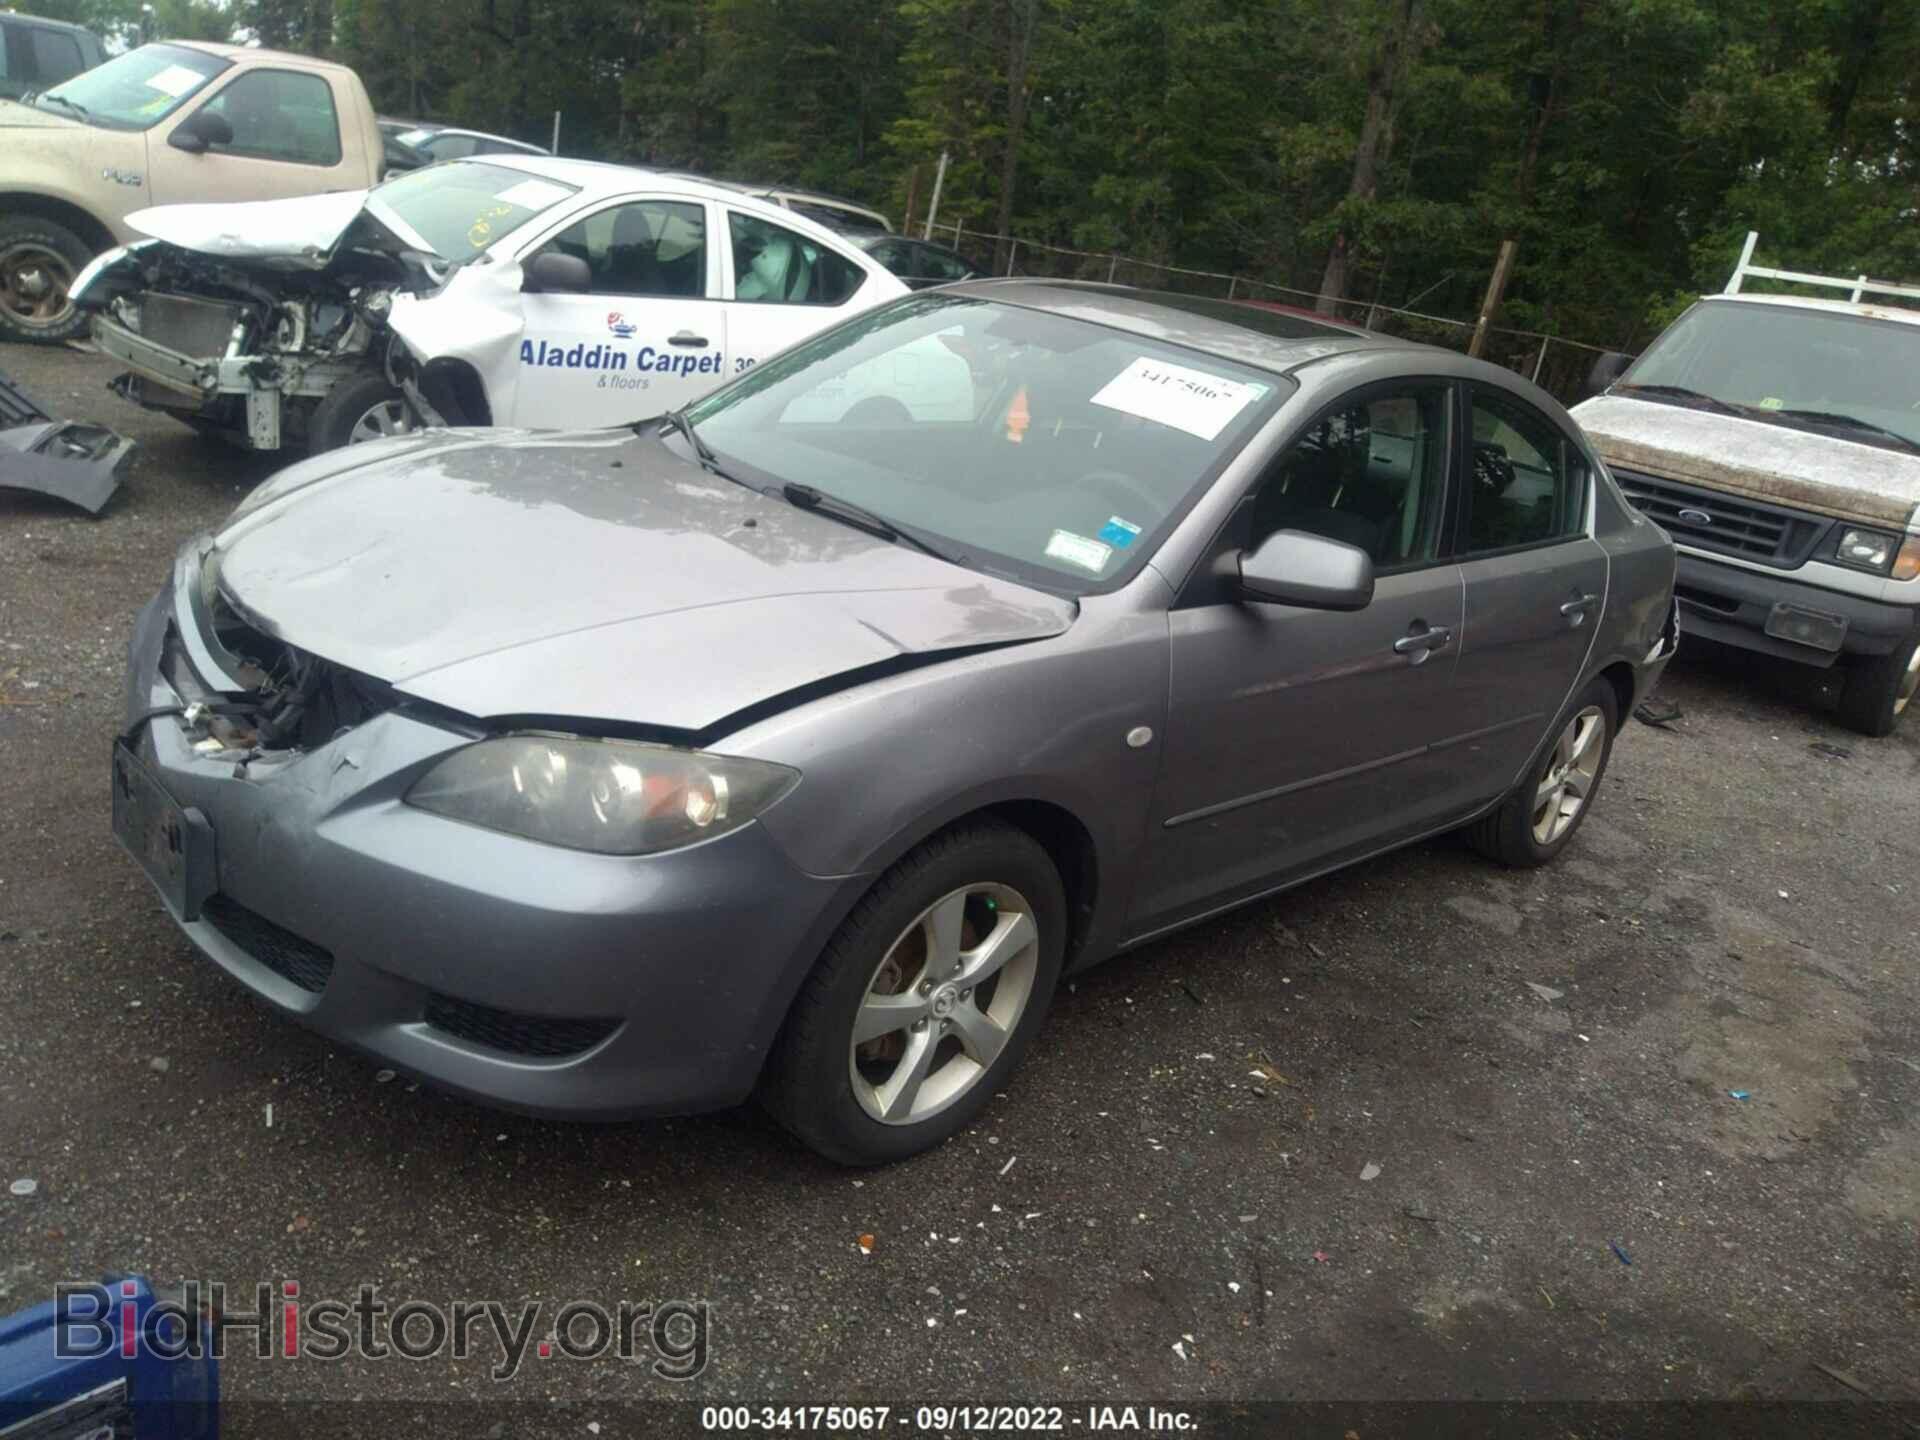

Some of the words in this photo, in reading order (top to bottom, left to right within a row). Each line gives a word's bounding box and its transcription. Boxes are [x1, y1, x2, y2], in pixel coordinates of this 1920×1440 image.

[520, 339, 627, 370] Aladdin
[636, 347, 723, 377] Carpet
[597, 374, 606, 388] &
[610, 375, 649, 389] floors
